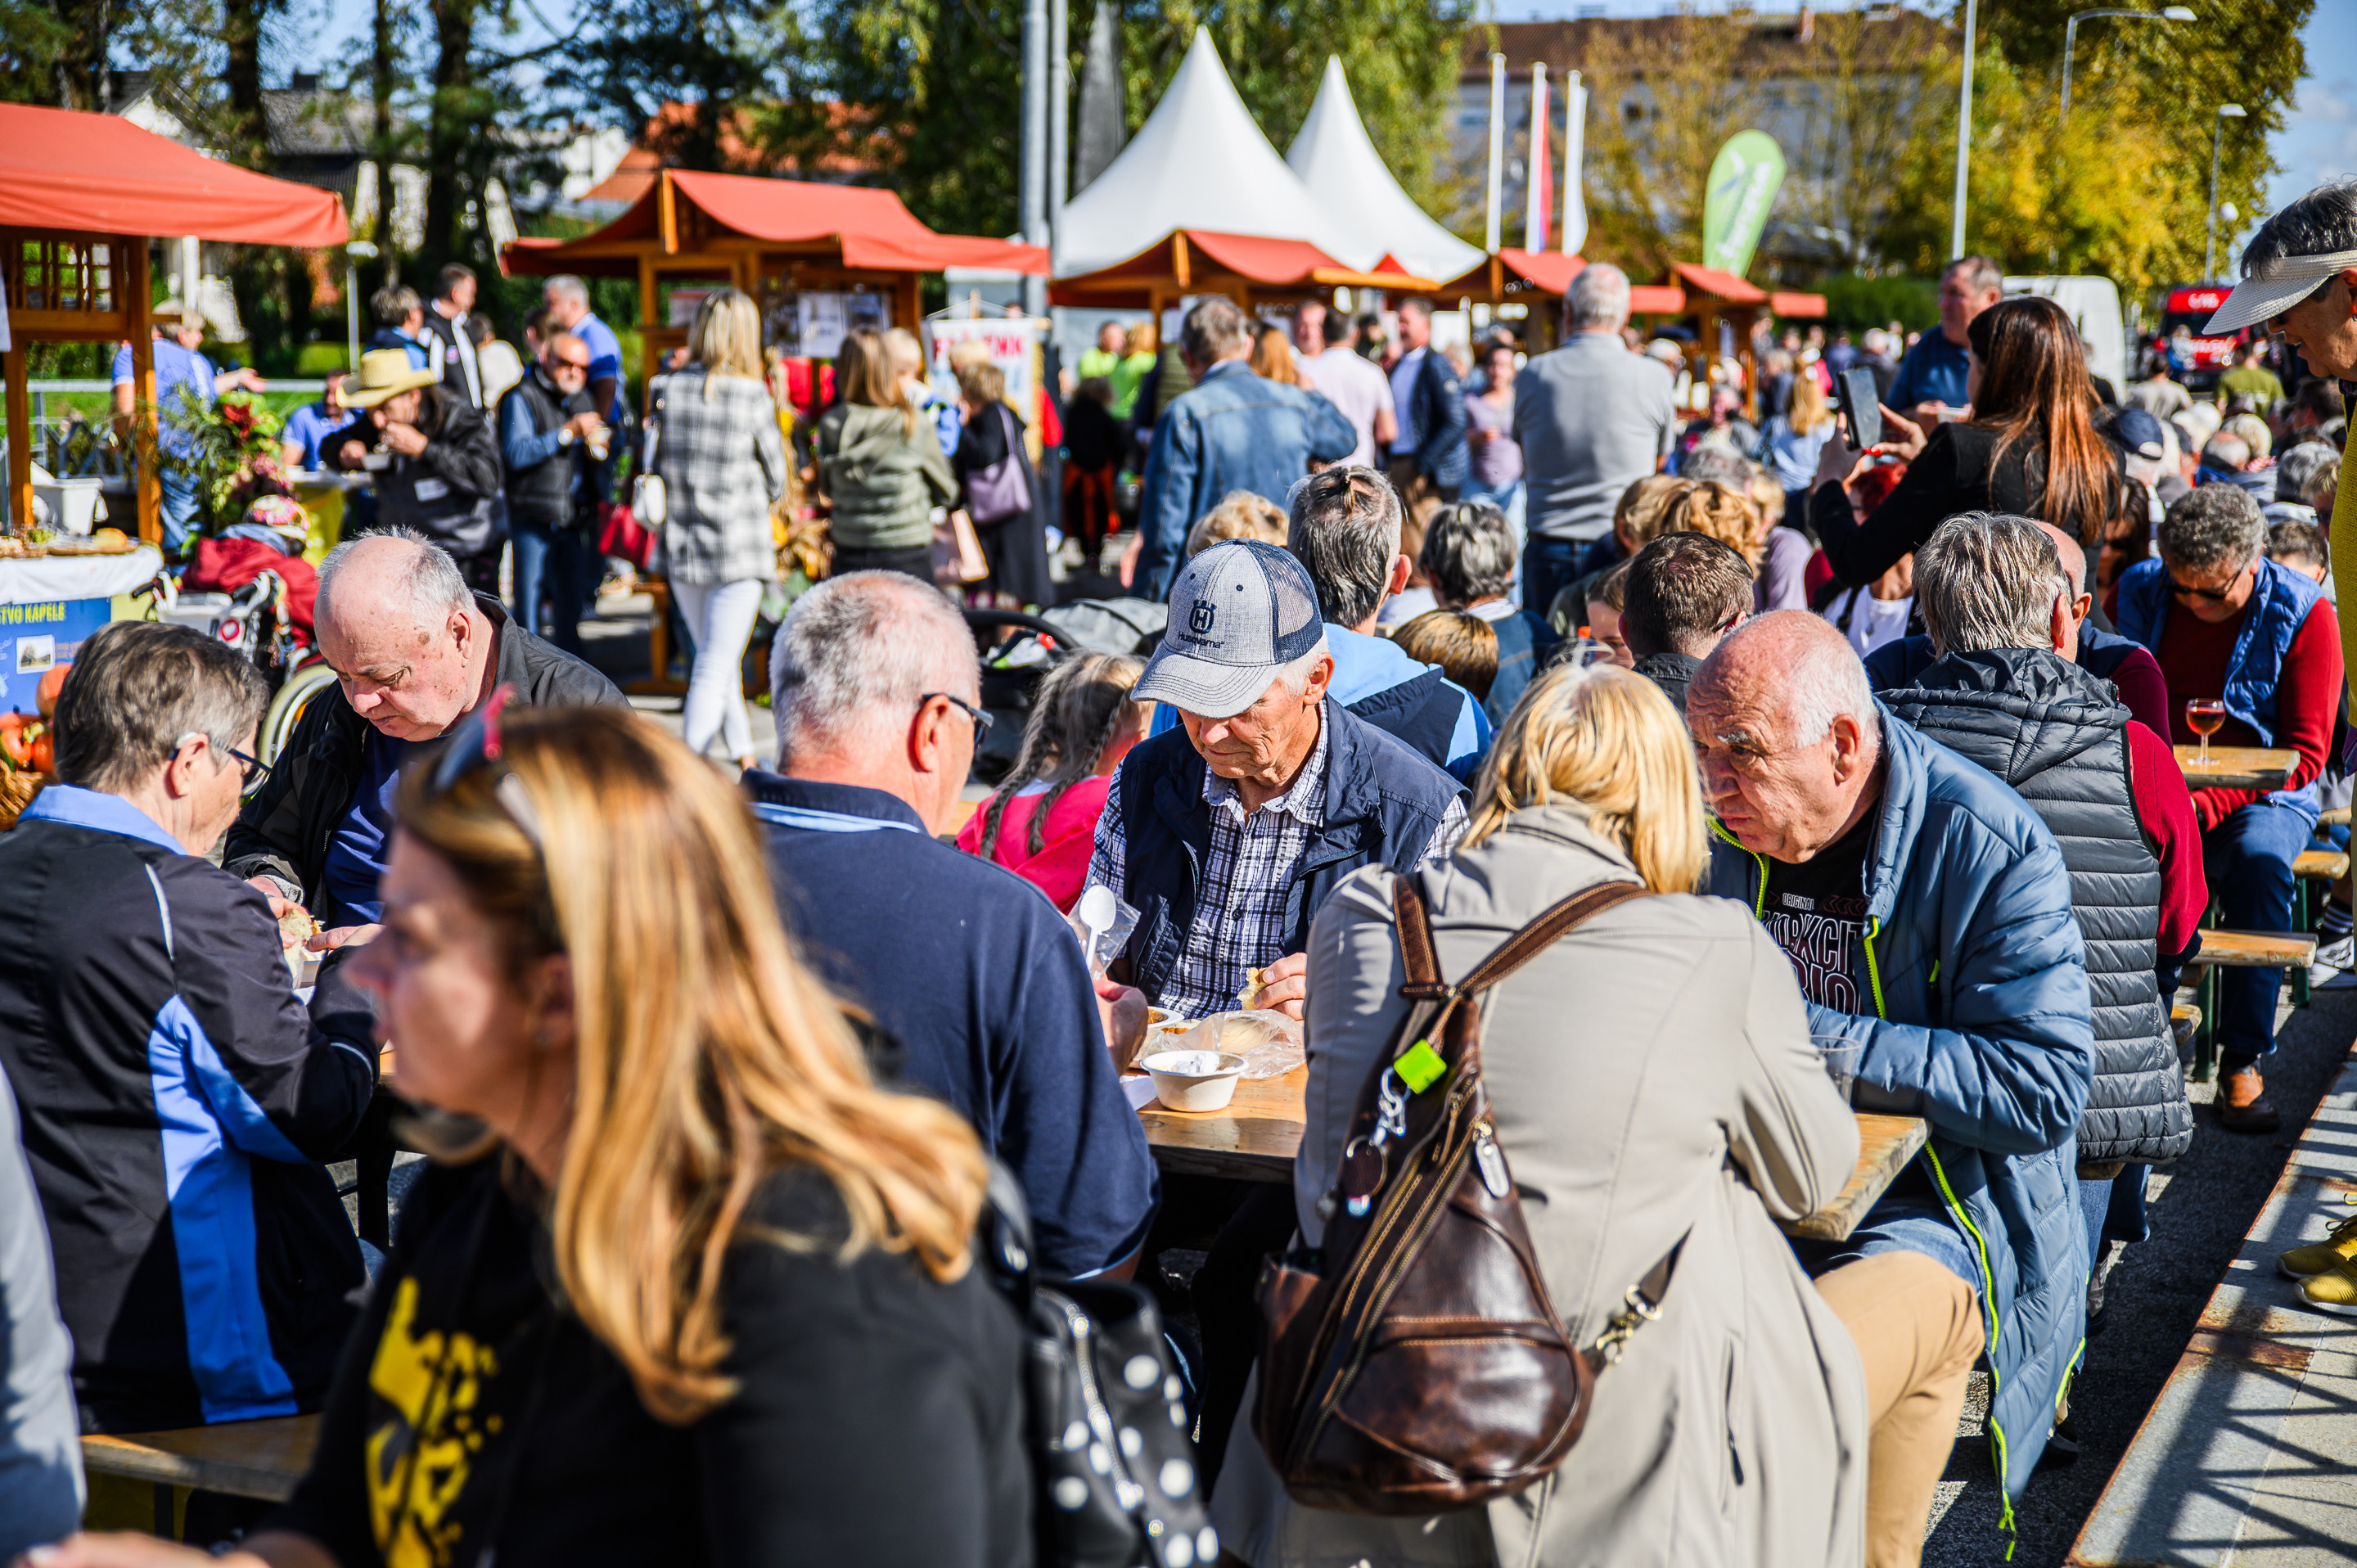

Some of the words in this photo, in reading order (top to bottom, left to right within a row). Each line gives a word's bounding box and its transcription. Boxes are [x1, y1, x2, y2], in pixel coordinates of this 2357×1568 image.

[0, 605, 24, 624] TVO
[25, 602, 66, 623] KAPELE
[1782, 893, 1814, 911] ORIGINAL
